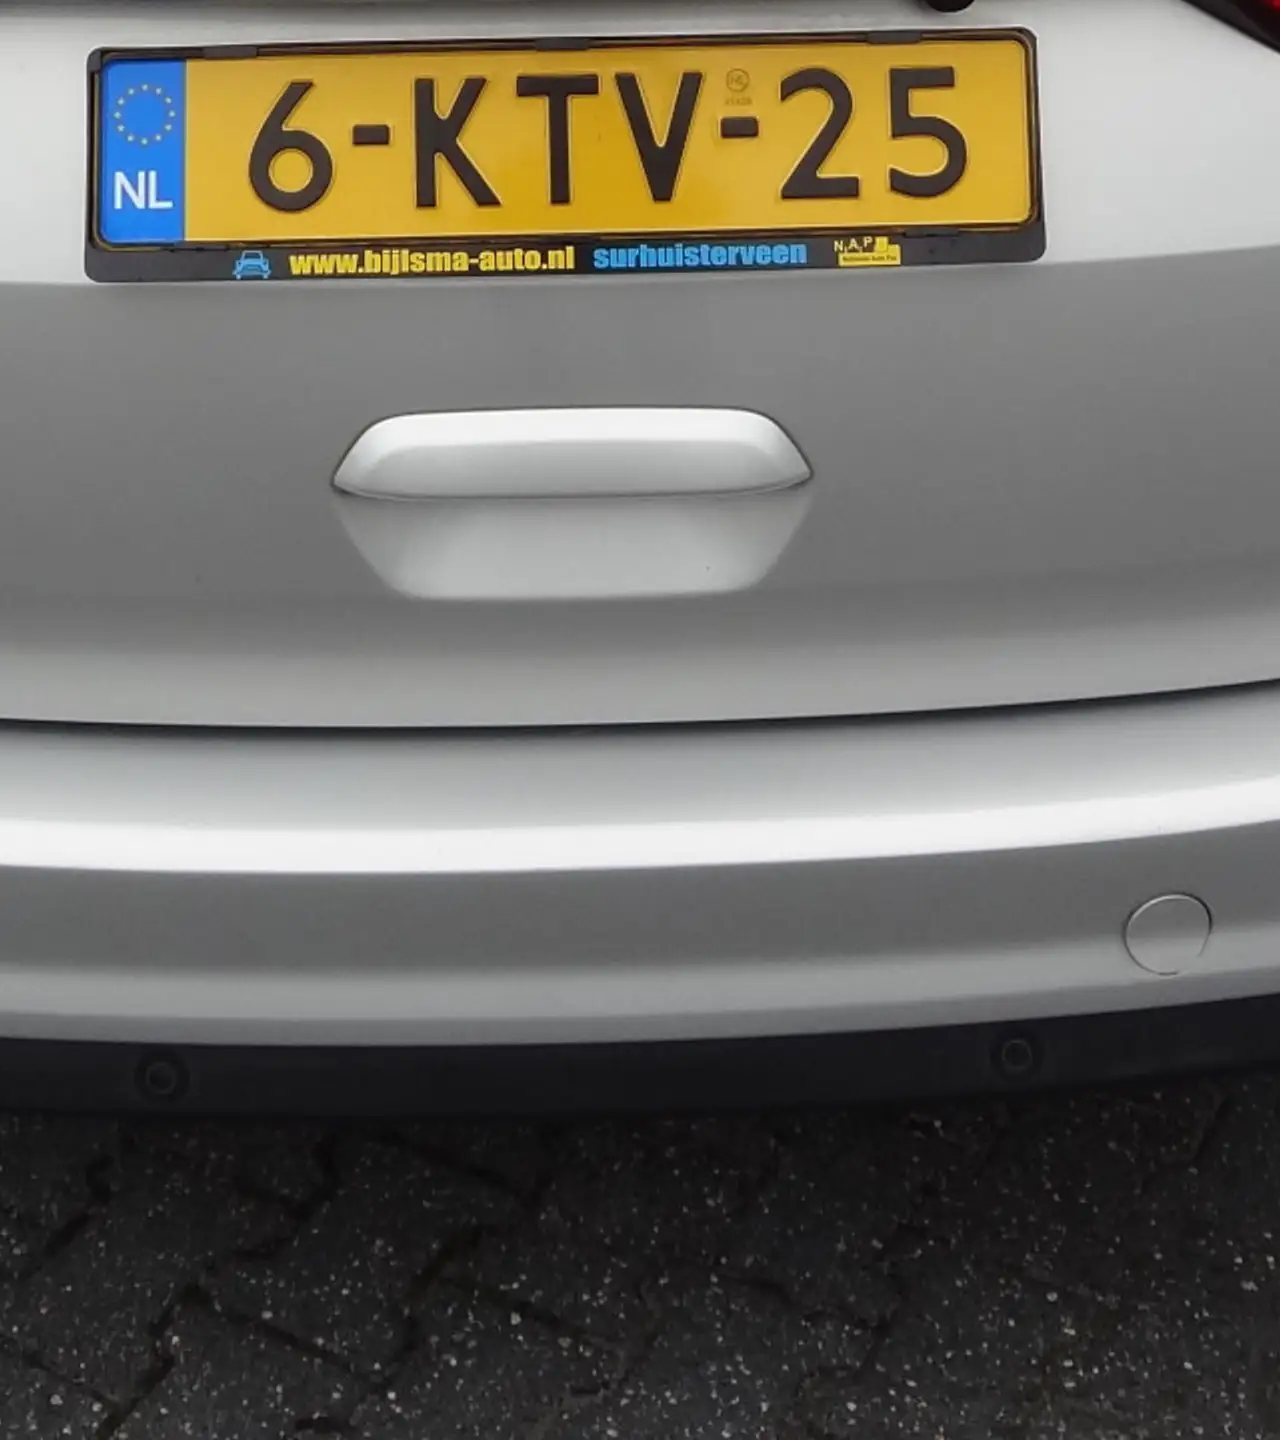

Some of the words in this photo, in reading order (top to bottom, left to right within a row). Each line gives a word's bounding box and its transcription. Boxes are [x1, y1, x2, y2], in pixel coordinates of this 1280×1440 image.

[248, 66, 967, 213] 6-KTV-25
[114, 171, 174, 210] NL
[288, 246, 576, 276] www.bijlsma-auto.nl
[593, 243, 808, 269] surhuisterveen
